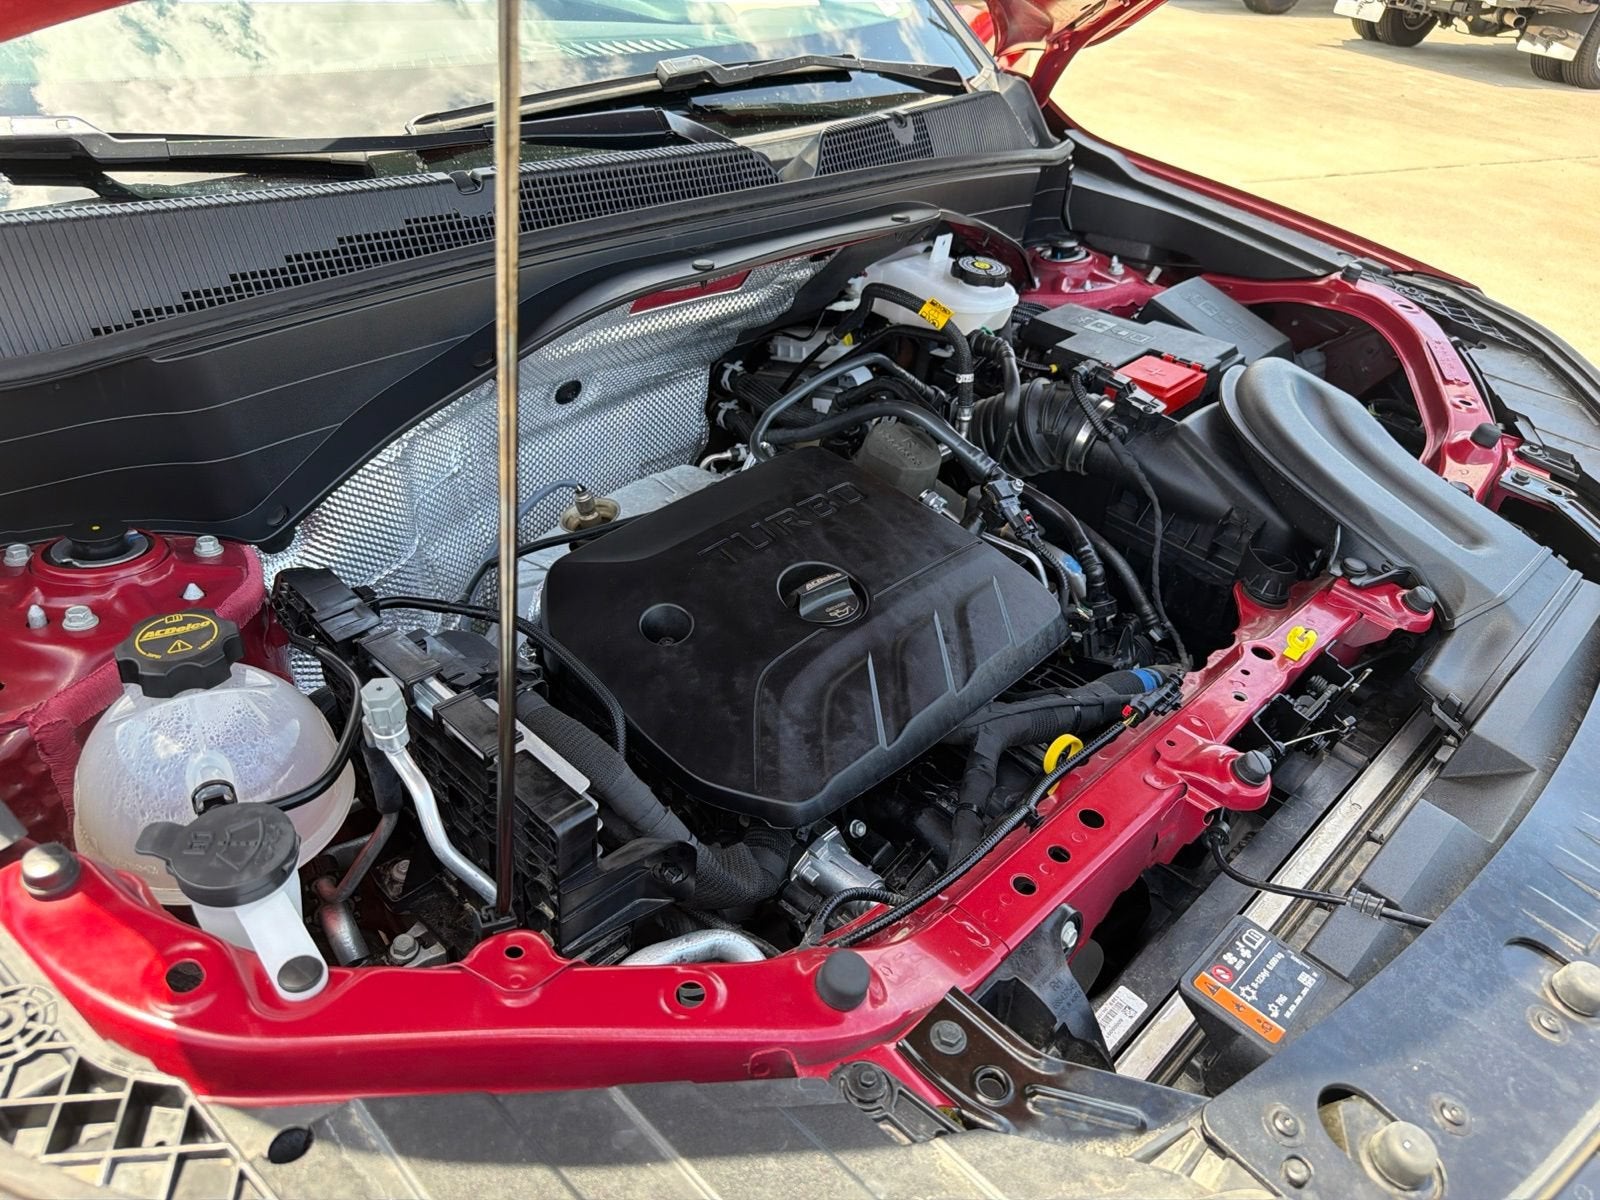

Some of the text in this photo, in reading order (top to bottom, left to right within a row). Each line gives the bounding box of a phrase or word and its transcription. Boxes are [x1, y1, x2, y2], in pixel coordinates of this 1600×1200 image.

[697, 481, 868, 564] TURBO
[805, 572, 842, 592] ACDelco
[142, 620, 212, 640] ACDelco
